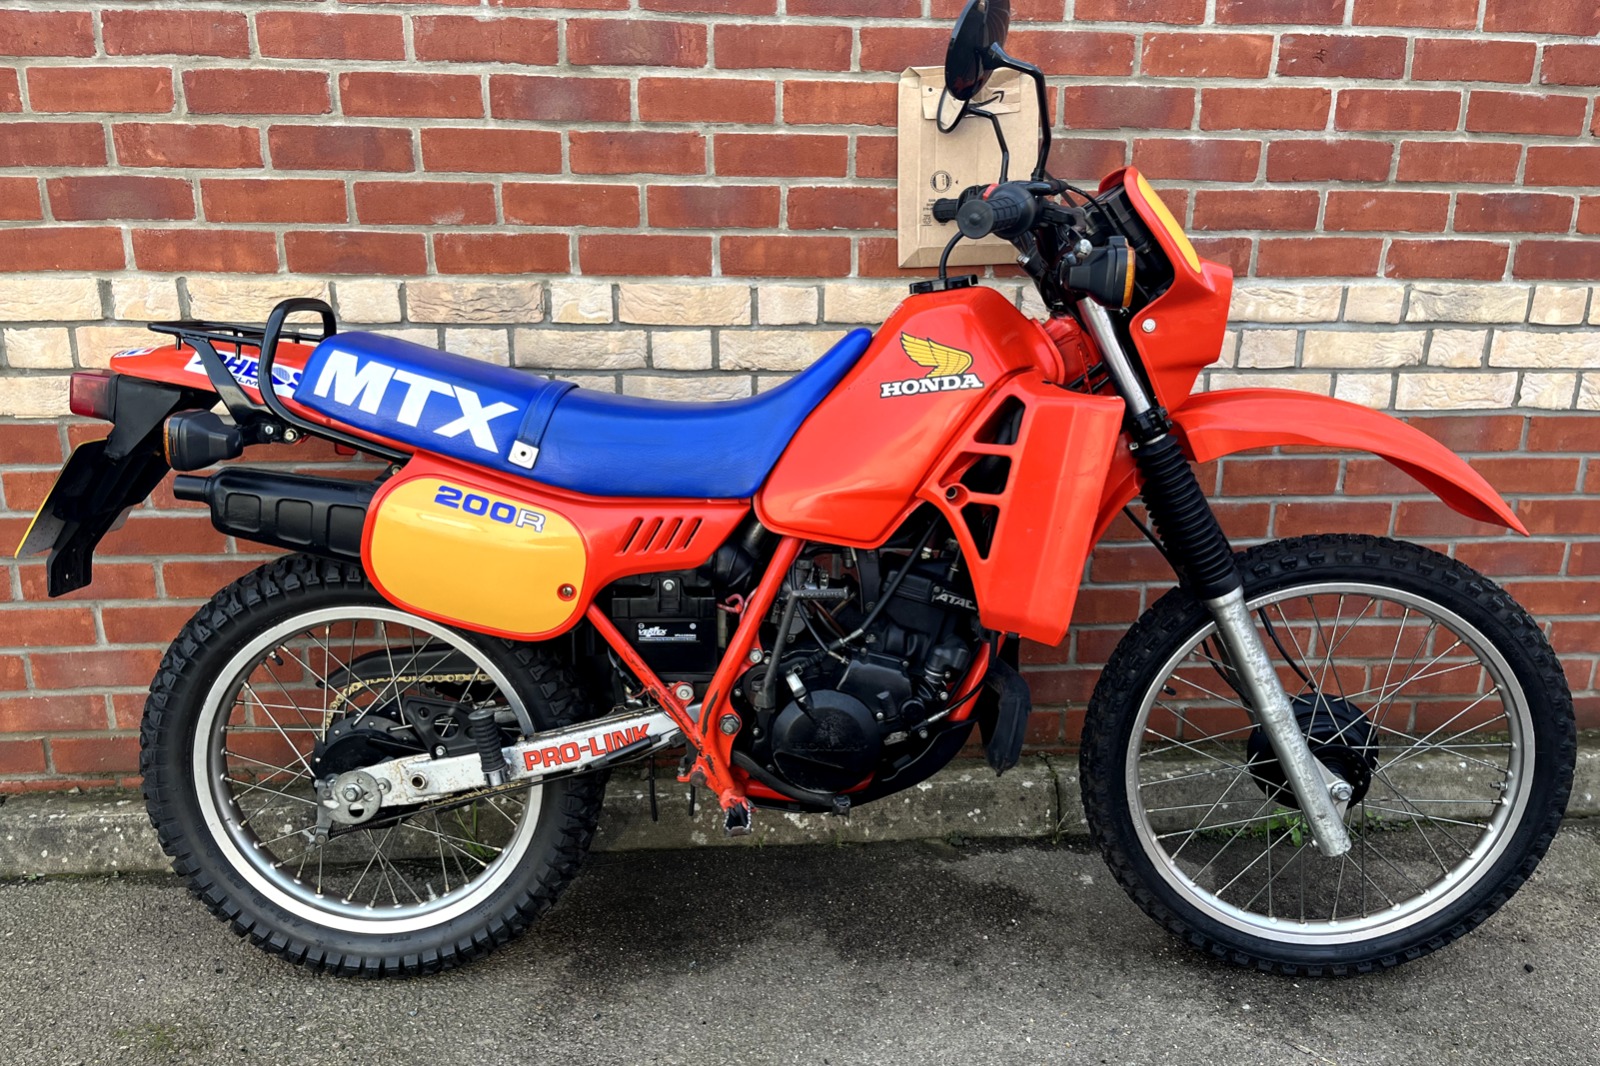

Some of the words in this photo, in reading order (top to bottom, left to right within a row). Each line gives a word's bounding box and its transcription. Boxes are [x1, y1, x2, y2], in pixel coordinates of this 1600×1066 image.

[313, 350, 519, 454] MTX
[880, 373, 984, 398] HONDA
[434, 485, 546, 533] 200R
[523, 723, 650, 771] PRO-LINK
